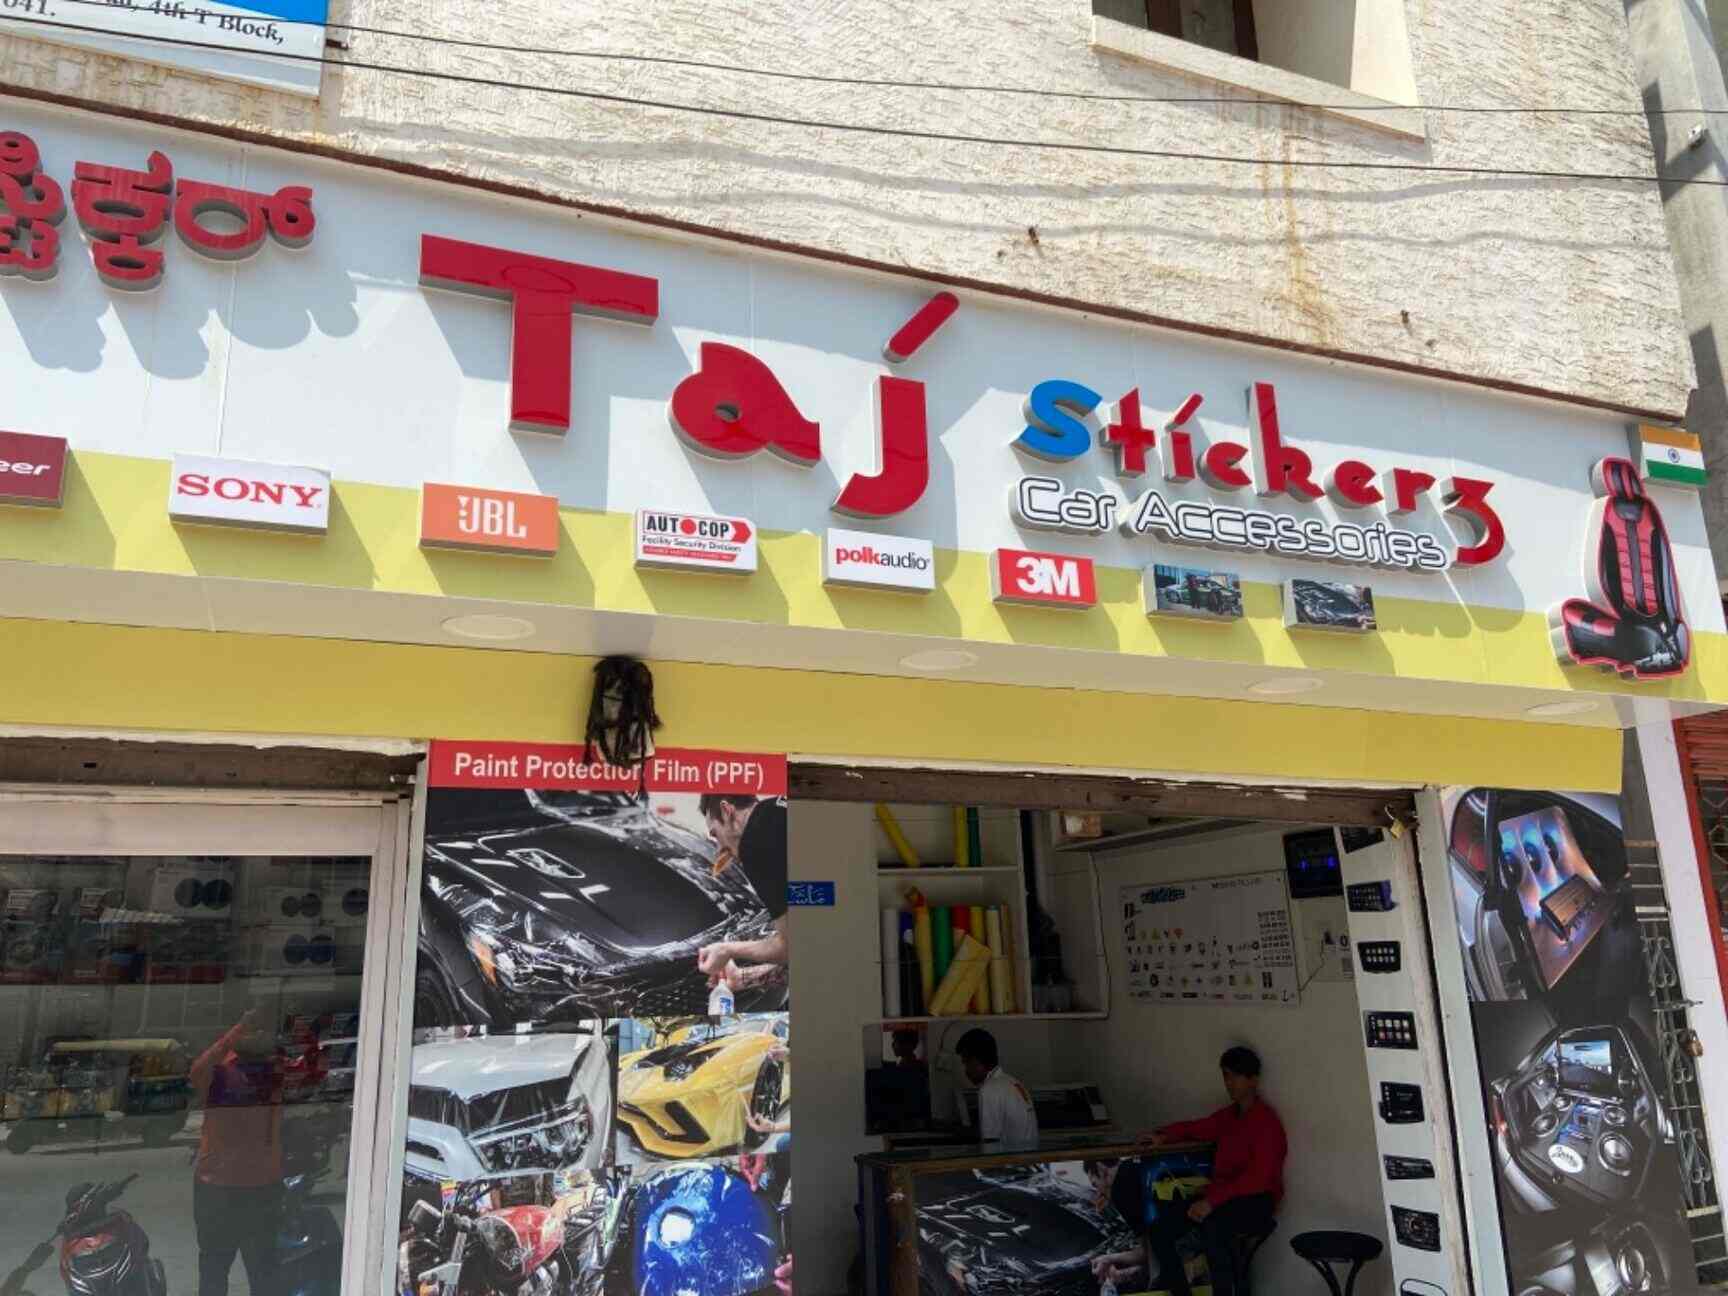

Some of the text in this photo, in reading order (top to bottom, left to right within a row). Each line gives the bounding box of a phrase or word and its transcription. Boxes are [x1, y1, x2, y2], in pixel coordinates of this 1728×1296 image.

[218, 14, 285, 45] Block,
[419, 233, 960, 518] Taj
[176, 473, 322, 509] SONY
[457, 494, 528, 539] JBL
[1016, 477, 1450, 570] Car Accessories
[1015, 556, 1081, 598] 3M
[454, 752, 518, 778] Paint
[653, 759, 700, 782] Film
[706, 760, 764, 790] (PPF)
